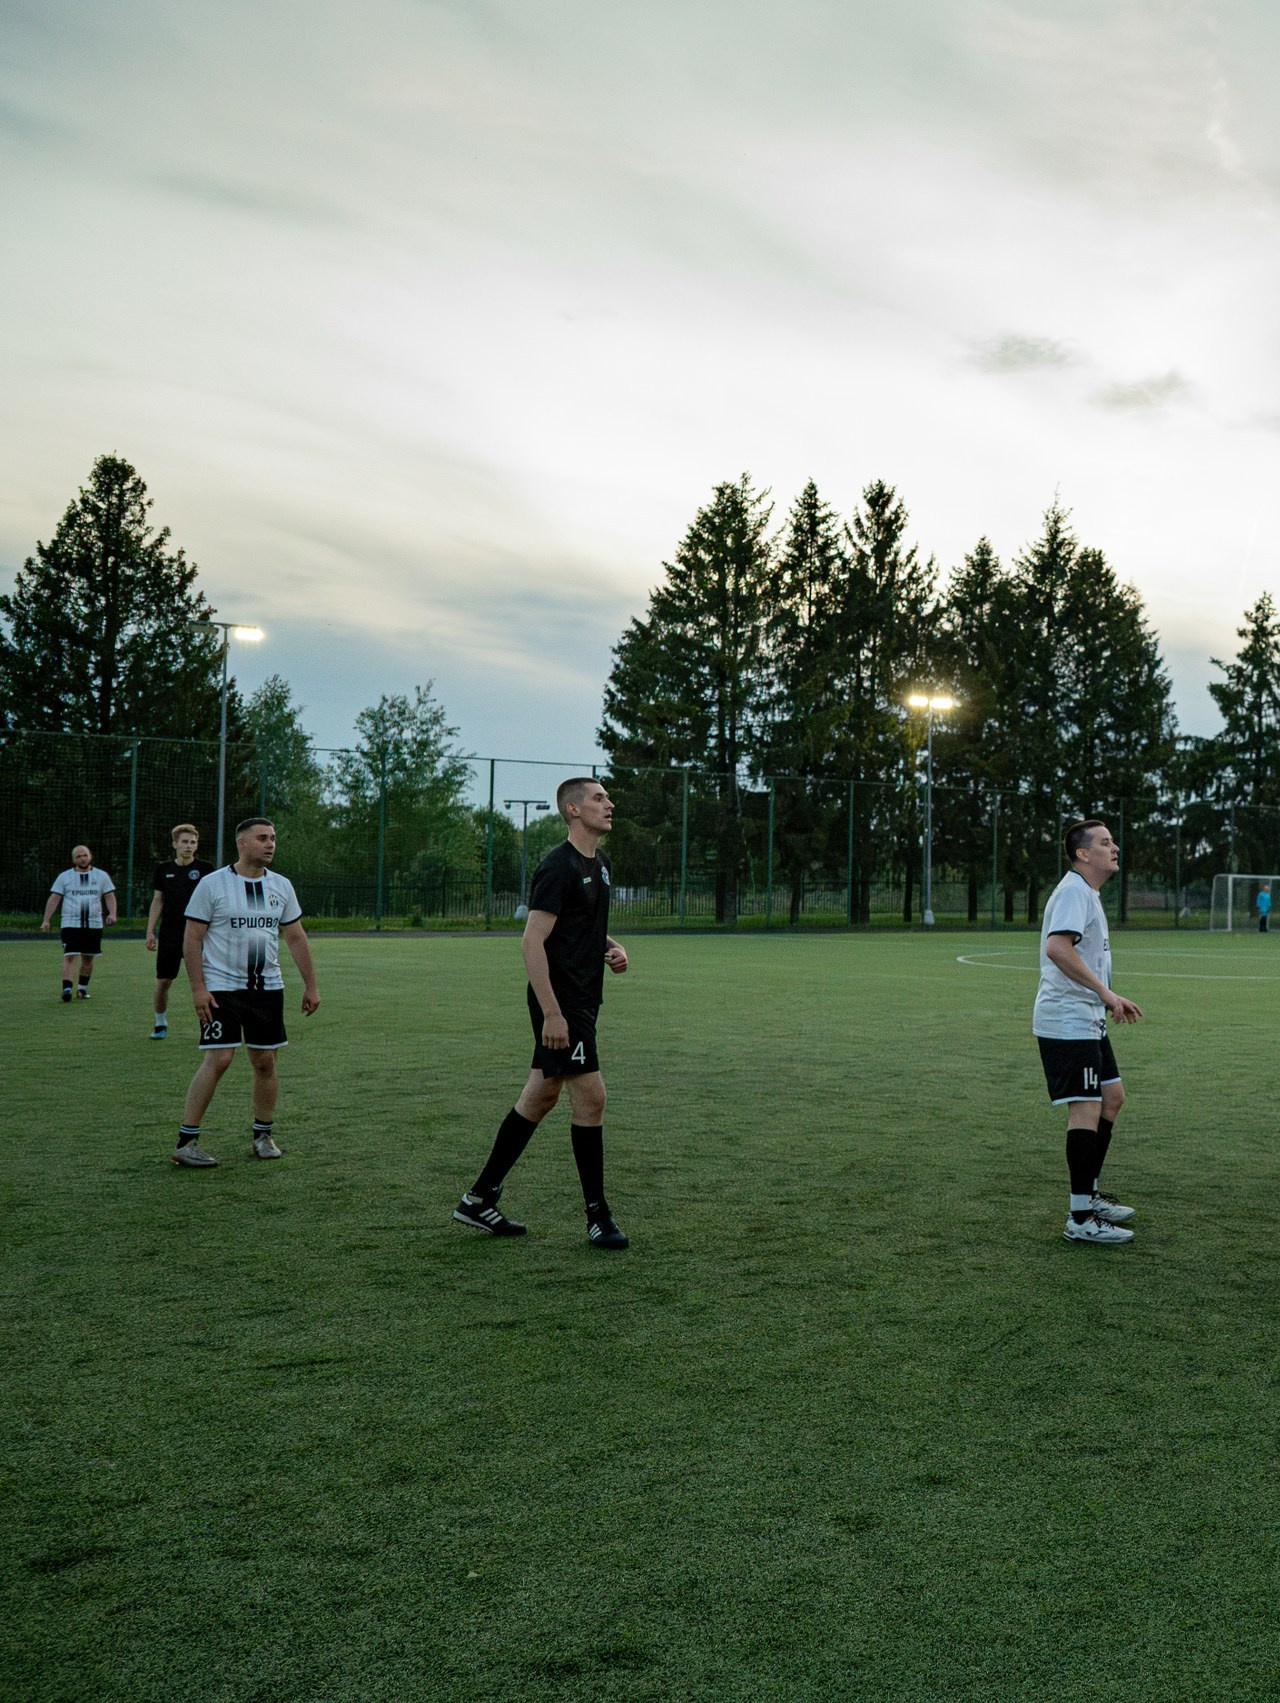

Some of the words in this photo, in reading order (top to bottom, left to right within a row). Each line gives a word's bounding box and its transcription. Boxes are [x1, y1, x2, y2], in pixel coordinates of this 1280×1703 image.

[203, 1020, 222, 1040] 23
[571, 1041, 586, 1065] 4
[1084, 1067, 1098, 1090] 14
